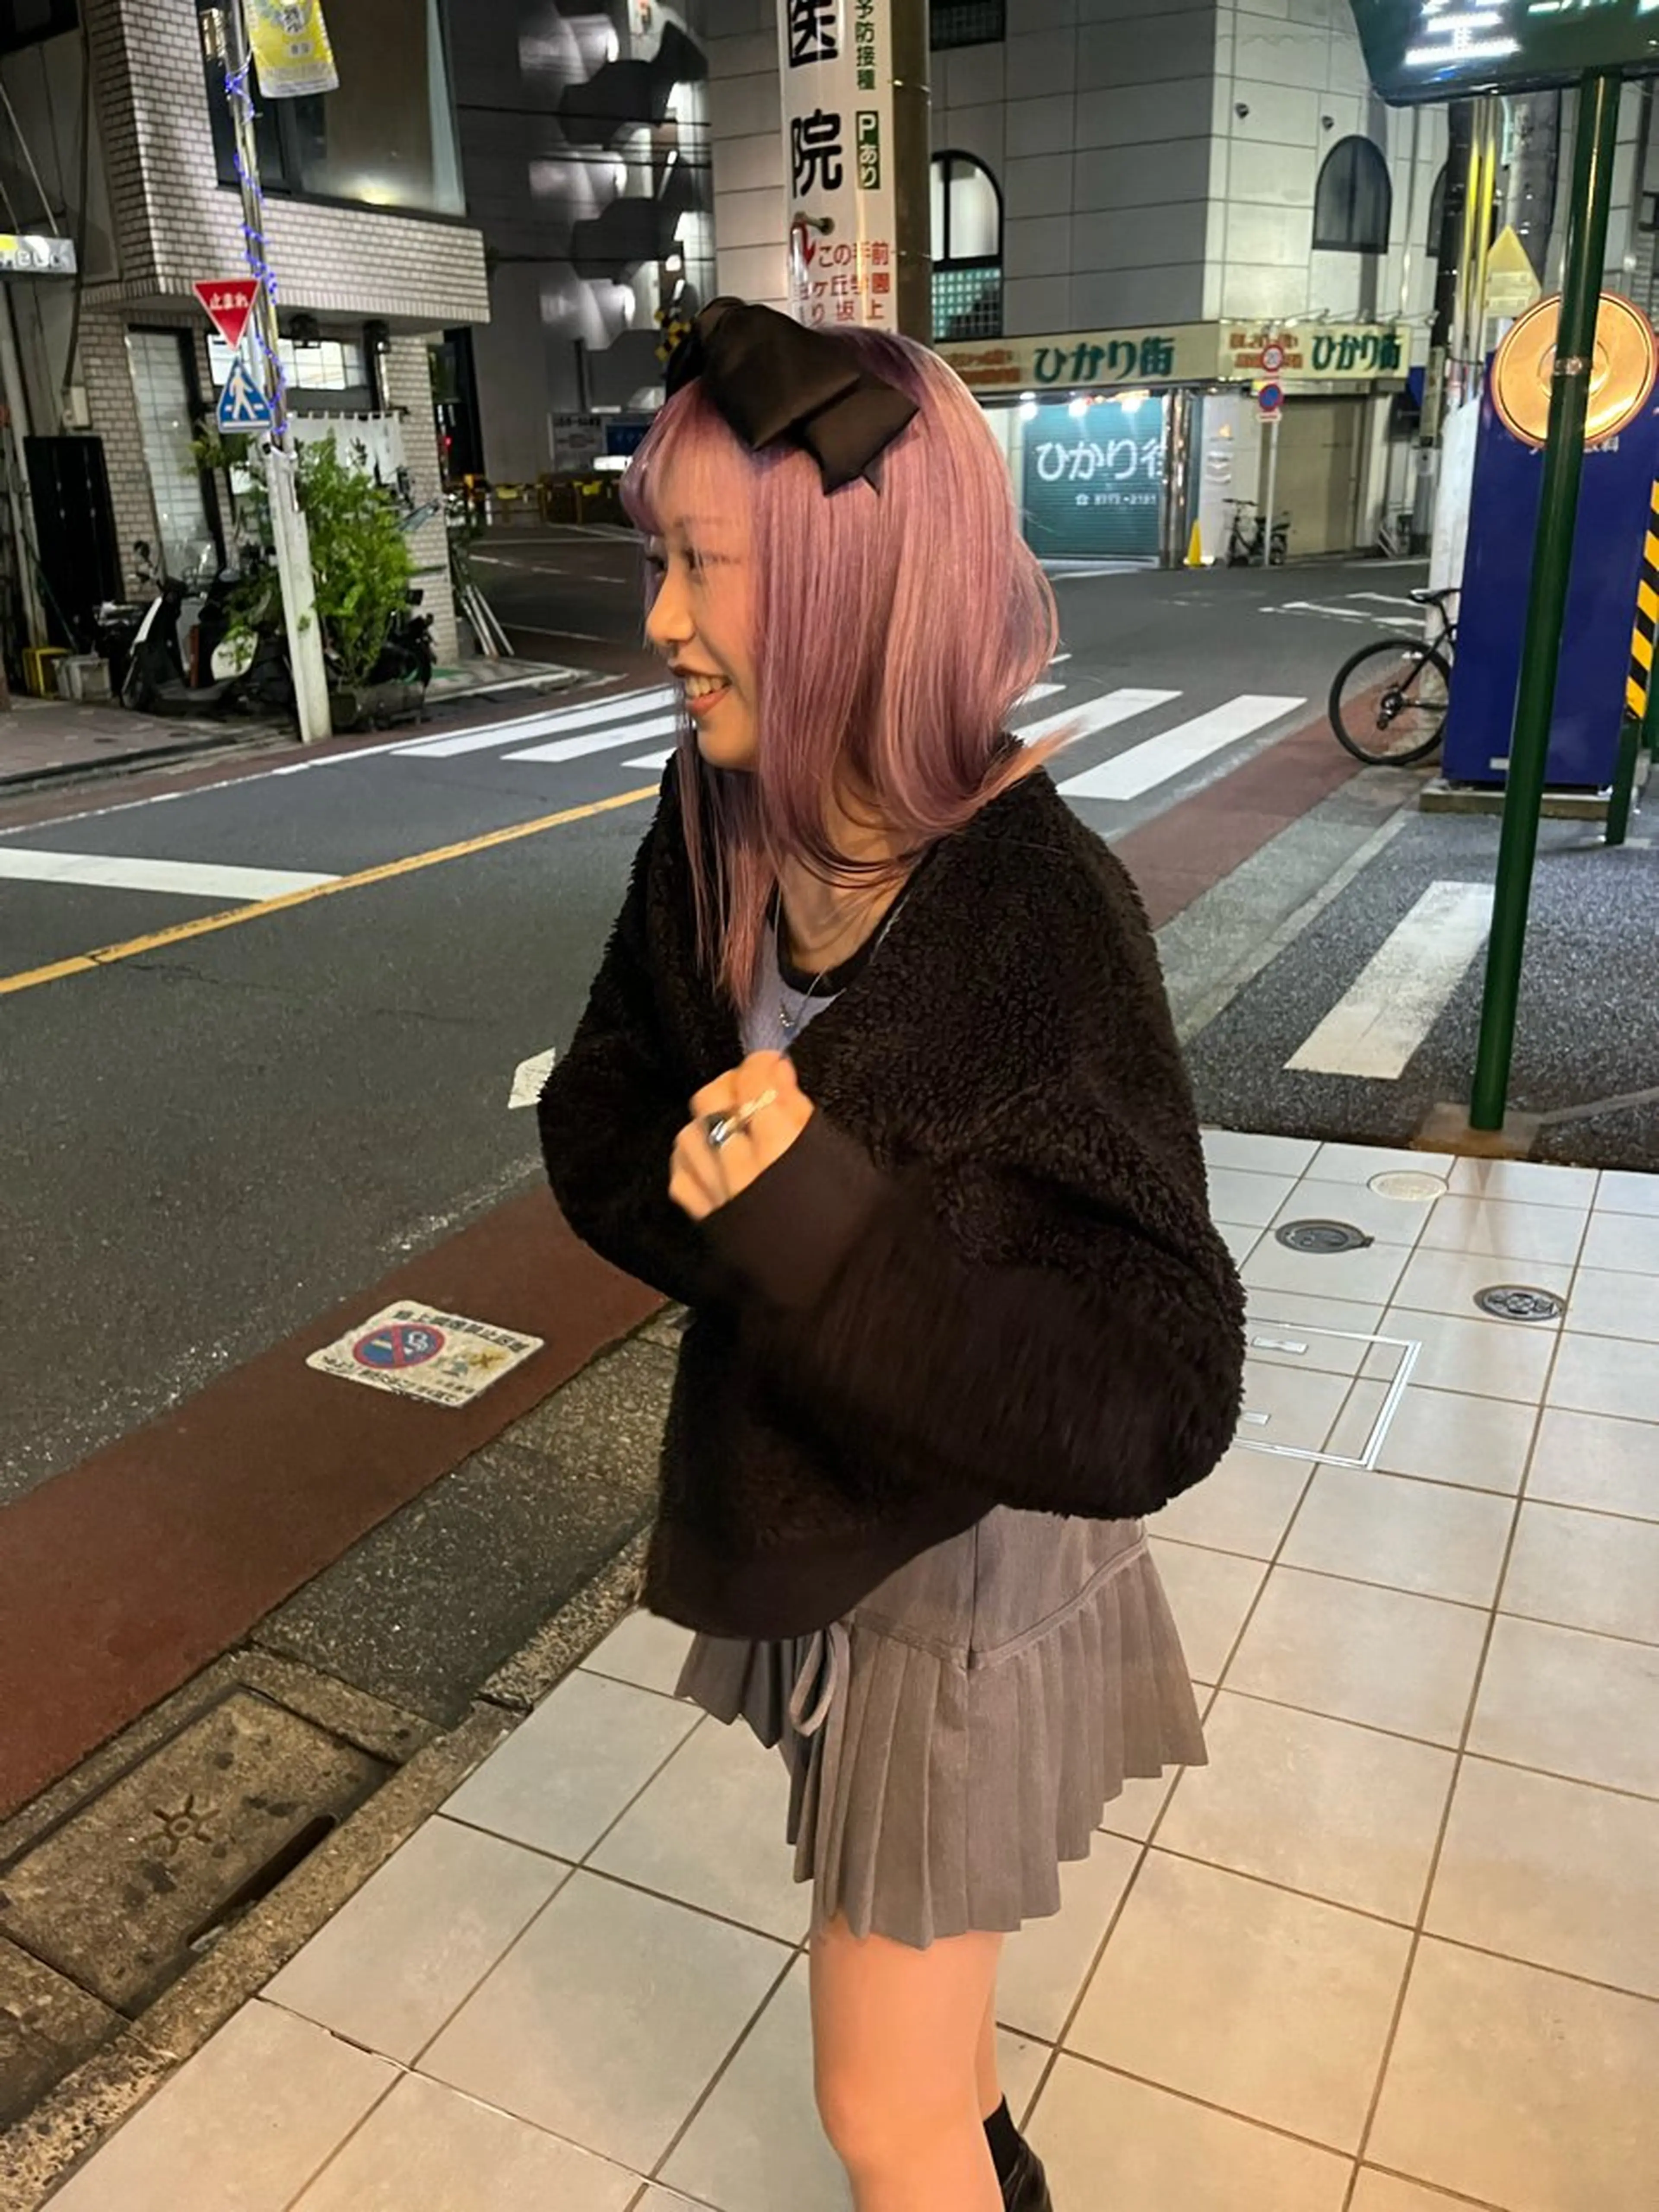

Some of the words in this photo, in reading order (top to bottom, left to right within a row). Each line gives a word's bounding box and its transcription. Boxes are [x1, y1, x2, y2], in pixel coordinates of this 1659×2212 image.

[858, 114, 878, 188] Pあり
[210, 292, 249, 311] 止まれ
[1033, 336, 1175, 384] ひかり街
[1312, 334, 1402, 371] ひかり街
